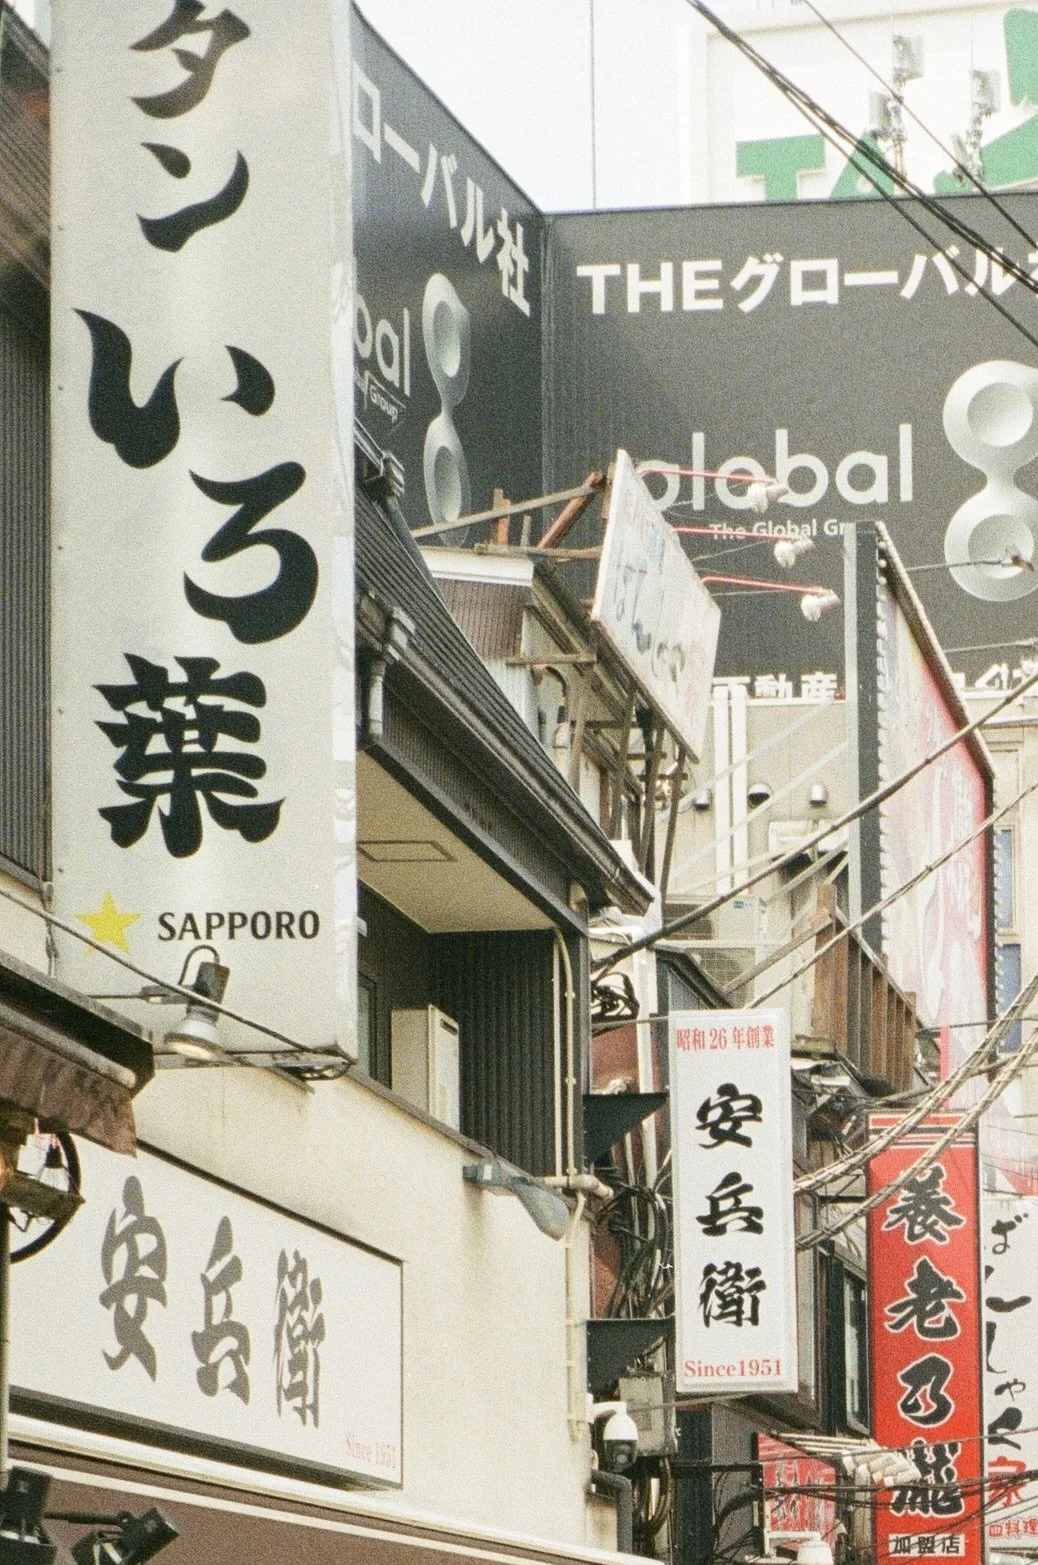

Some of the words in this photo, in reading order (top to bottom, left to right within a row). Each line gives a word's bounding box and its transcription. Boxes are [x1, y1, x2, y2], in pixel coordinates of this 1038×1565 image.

[353, 62, 531, 318] ローバル社
[710, 522, 746, 541] The
[753, 518, 817, 539] Global
[157, 910, 321, 941] SAPPORO
[676, 1026, 776, 1051] 昭和26年創業
[695, 1082, 767, 1329] 安兵衛
[99, 1175, 327, 1429] 安兵衛
[892, 1535, 962, 1556] 加盟店
